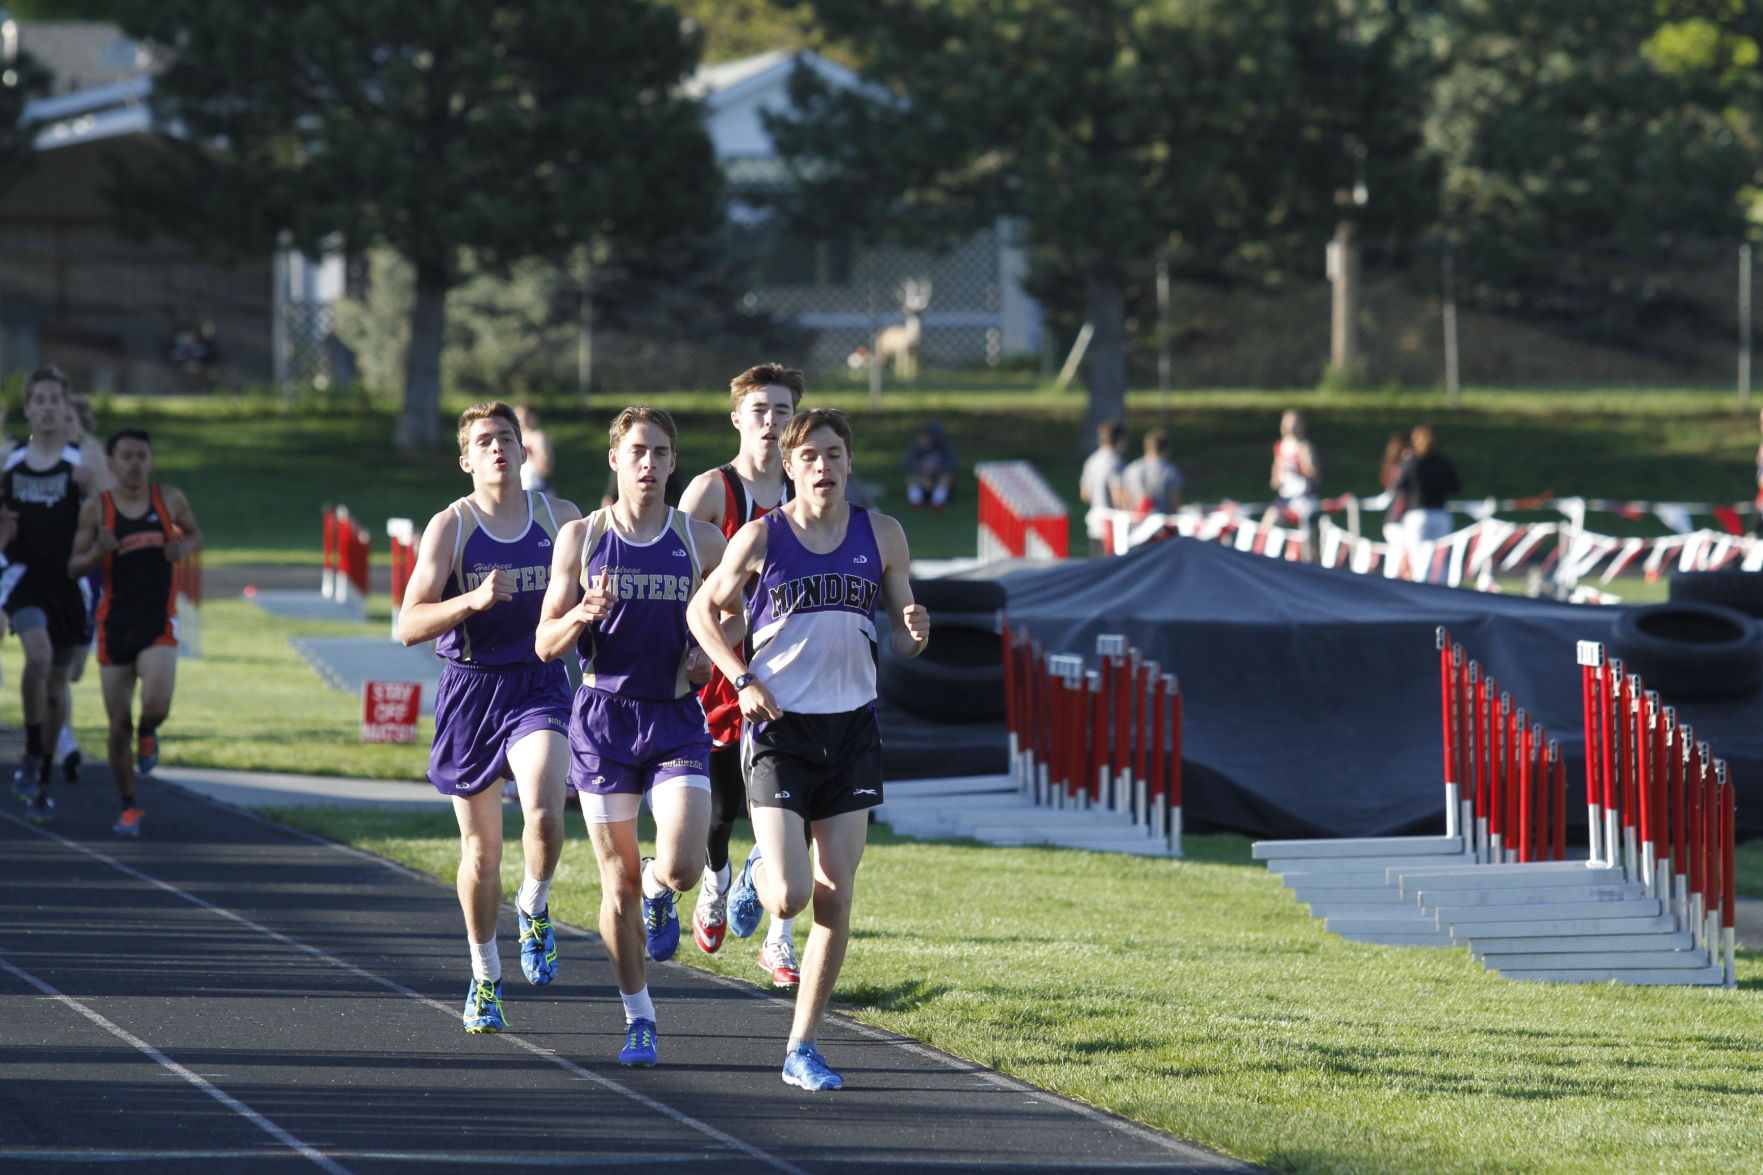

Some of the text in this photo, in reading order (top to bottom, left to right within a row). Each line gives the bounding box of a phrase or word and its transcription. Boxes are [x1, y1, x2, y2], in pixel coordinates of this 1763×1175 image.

[466, 565, 552, 593] DTER
[769, 573, 878, 620] MINDEN
[372, 683, 413, 701] STAY
[373, 702, 409, 722] OFF
